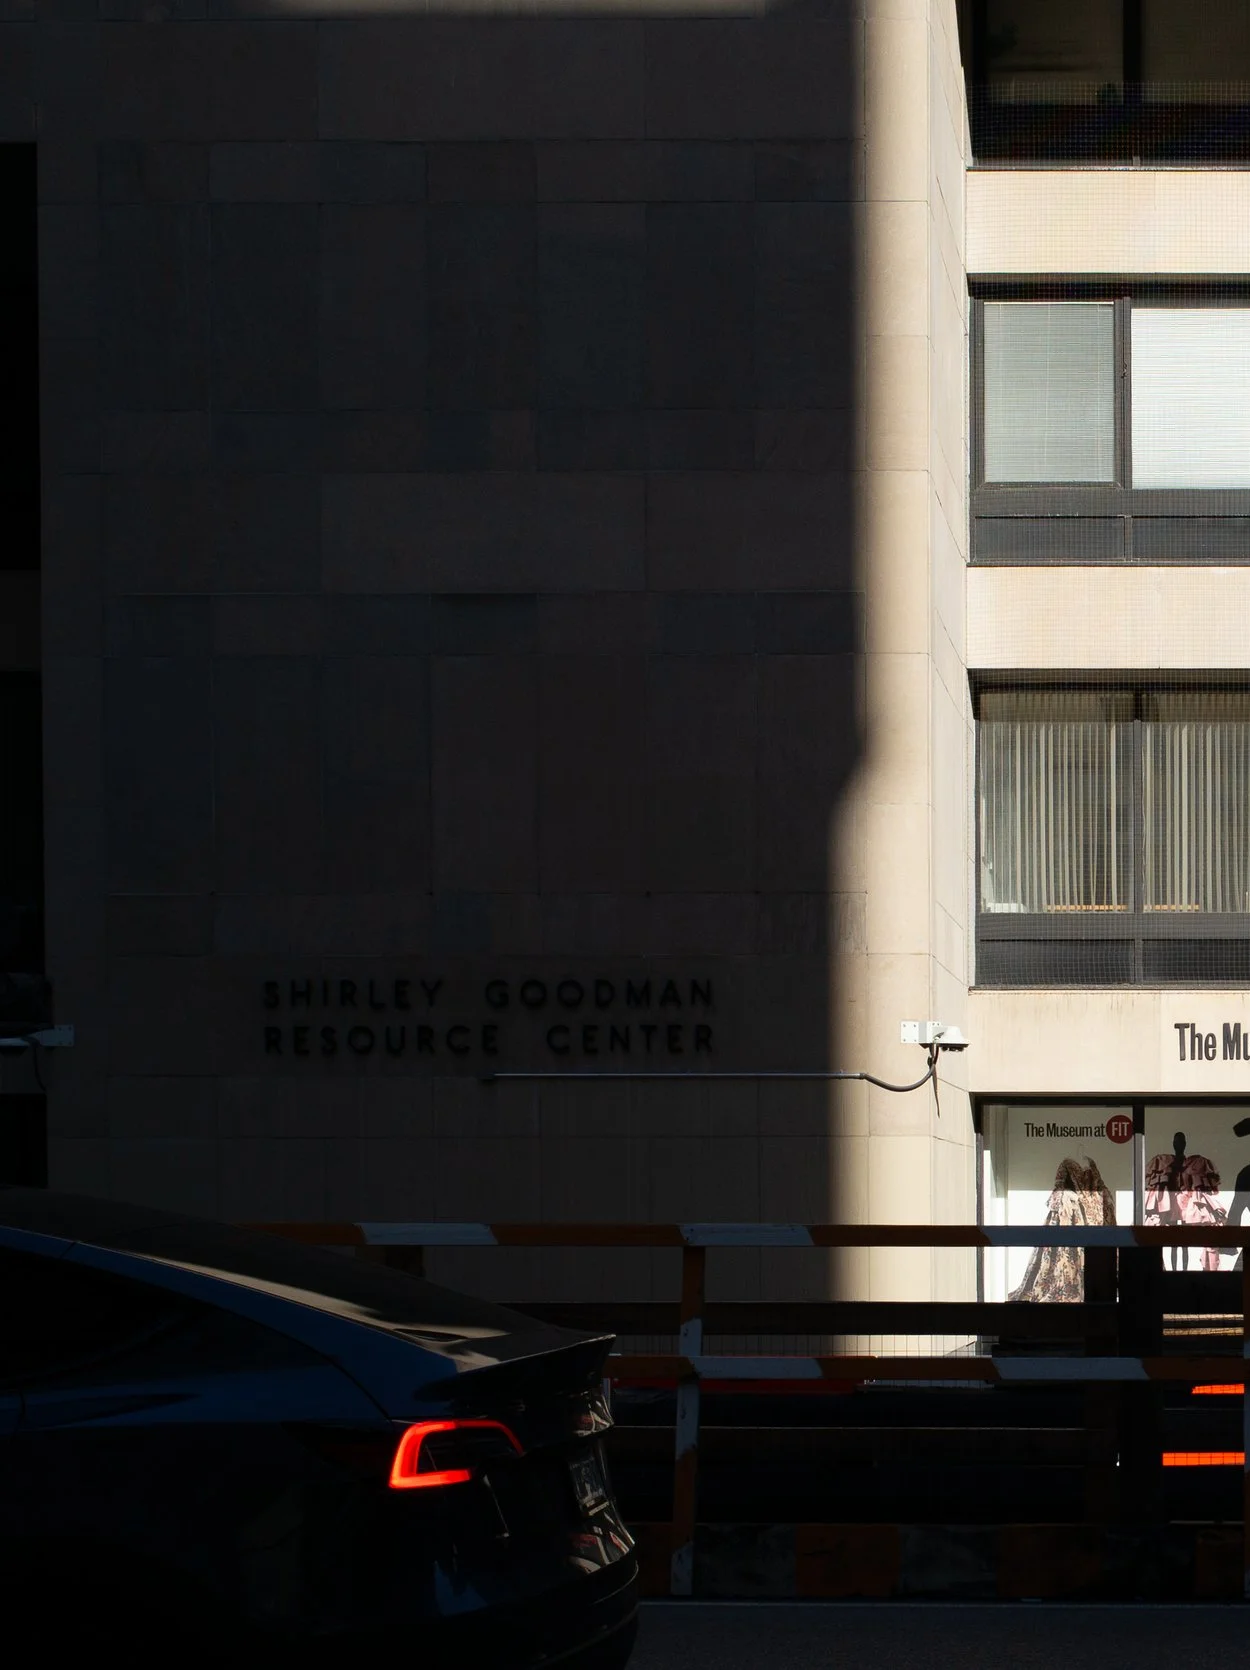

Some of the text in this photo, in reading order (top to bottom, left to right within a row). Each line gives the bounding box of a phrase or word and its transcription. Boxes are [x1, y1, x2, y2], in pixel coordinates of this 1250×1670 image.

[263, 978, 713, 1010] SHIRLEY GOODMAN
[263, 1024, 713, 1056] RESOURCE CENTER
[1174, 1023, 1217, 1061] The
[1024, 1121, 1130, 1137] The Museum at FIT
